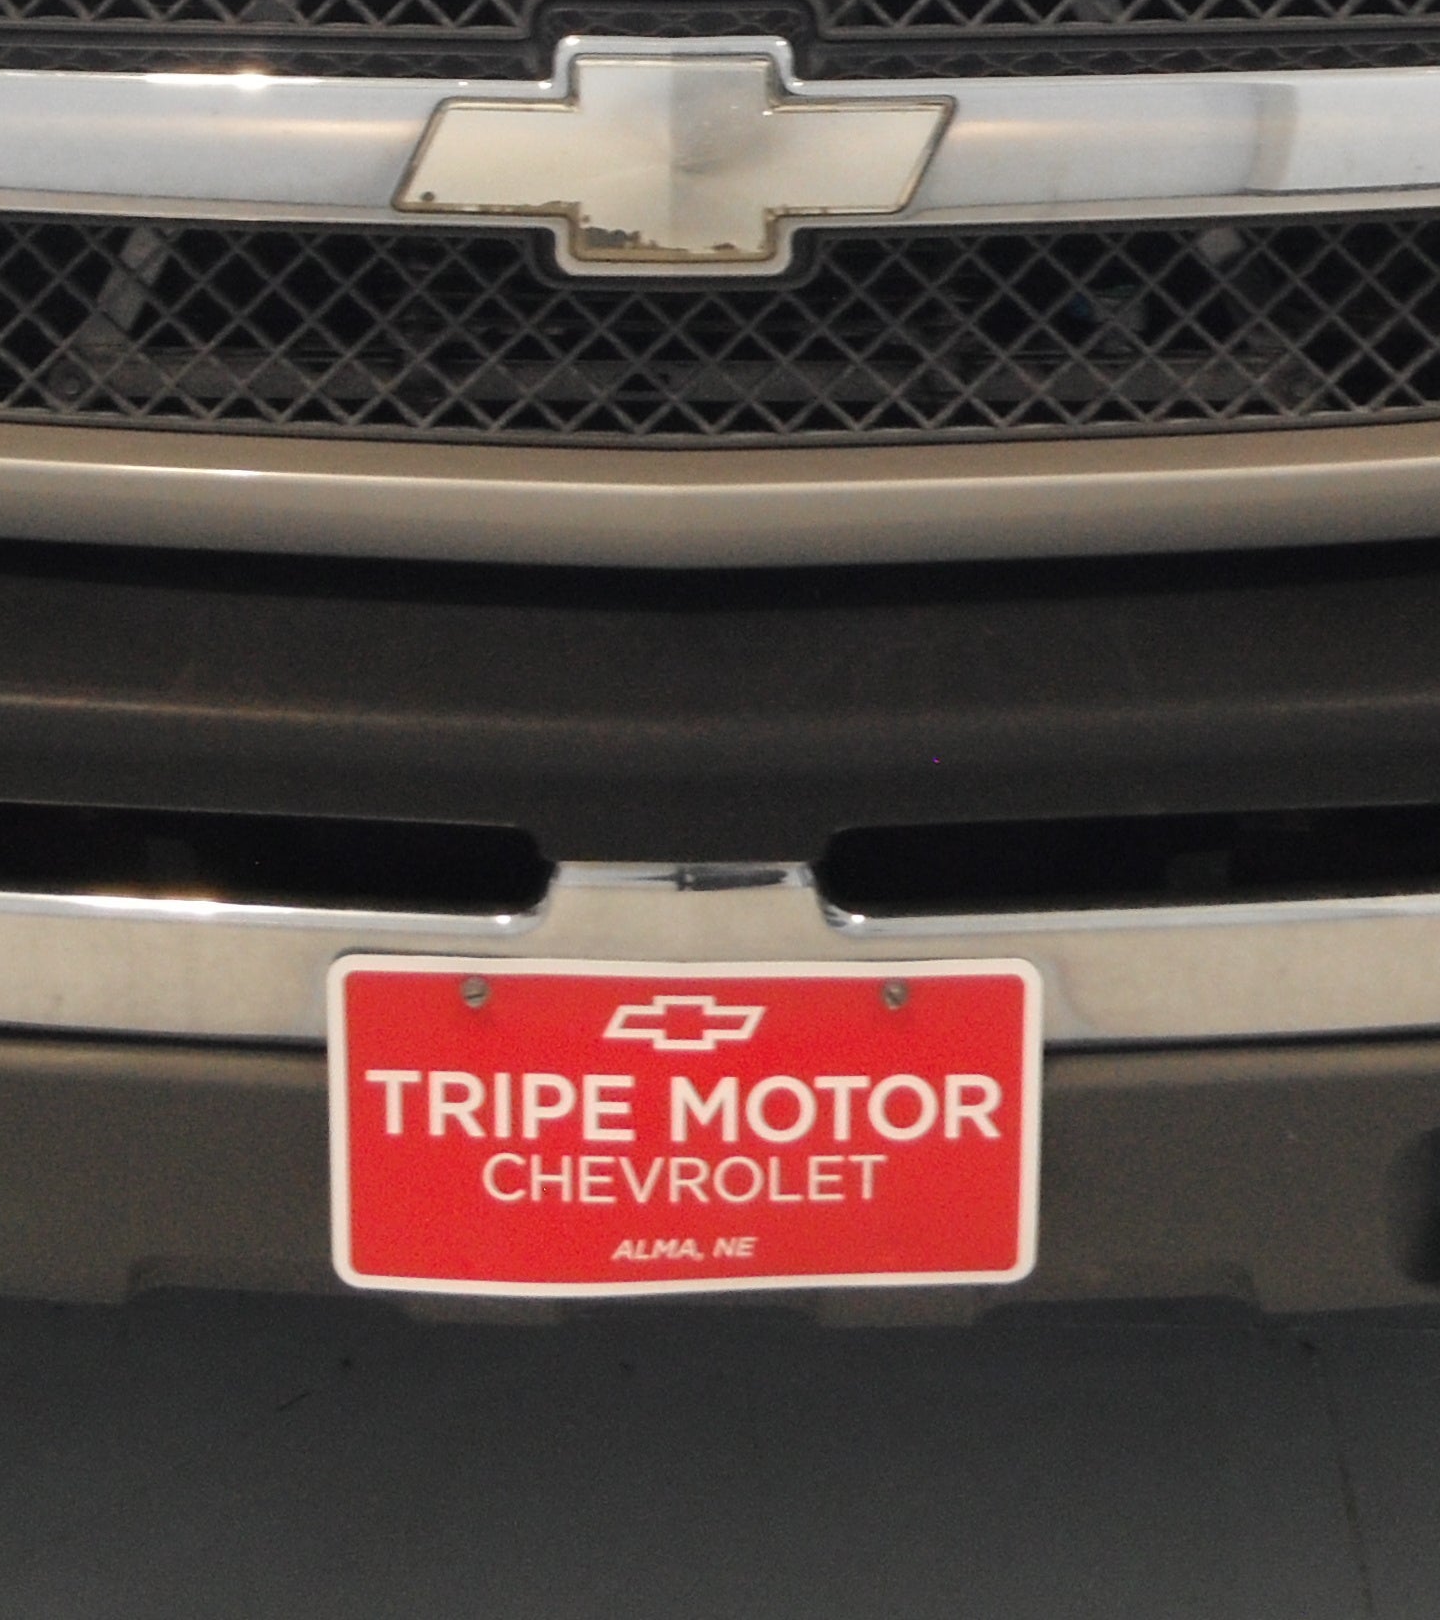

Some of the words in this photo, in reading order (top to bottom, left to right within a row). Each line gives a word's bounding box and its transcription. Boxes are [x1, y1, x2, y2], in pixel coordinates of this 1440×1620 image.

[364, 1069, 637, 1143] TRIPE
[669, 1072, 1003, 1144] MOTOR
[481, 1152, 888, 1205] CHEVROLET
[611, 1238, 705, 1262] ALMA,
[712, 1236, 757, 1258] NE
